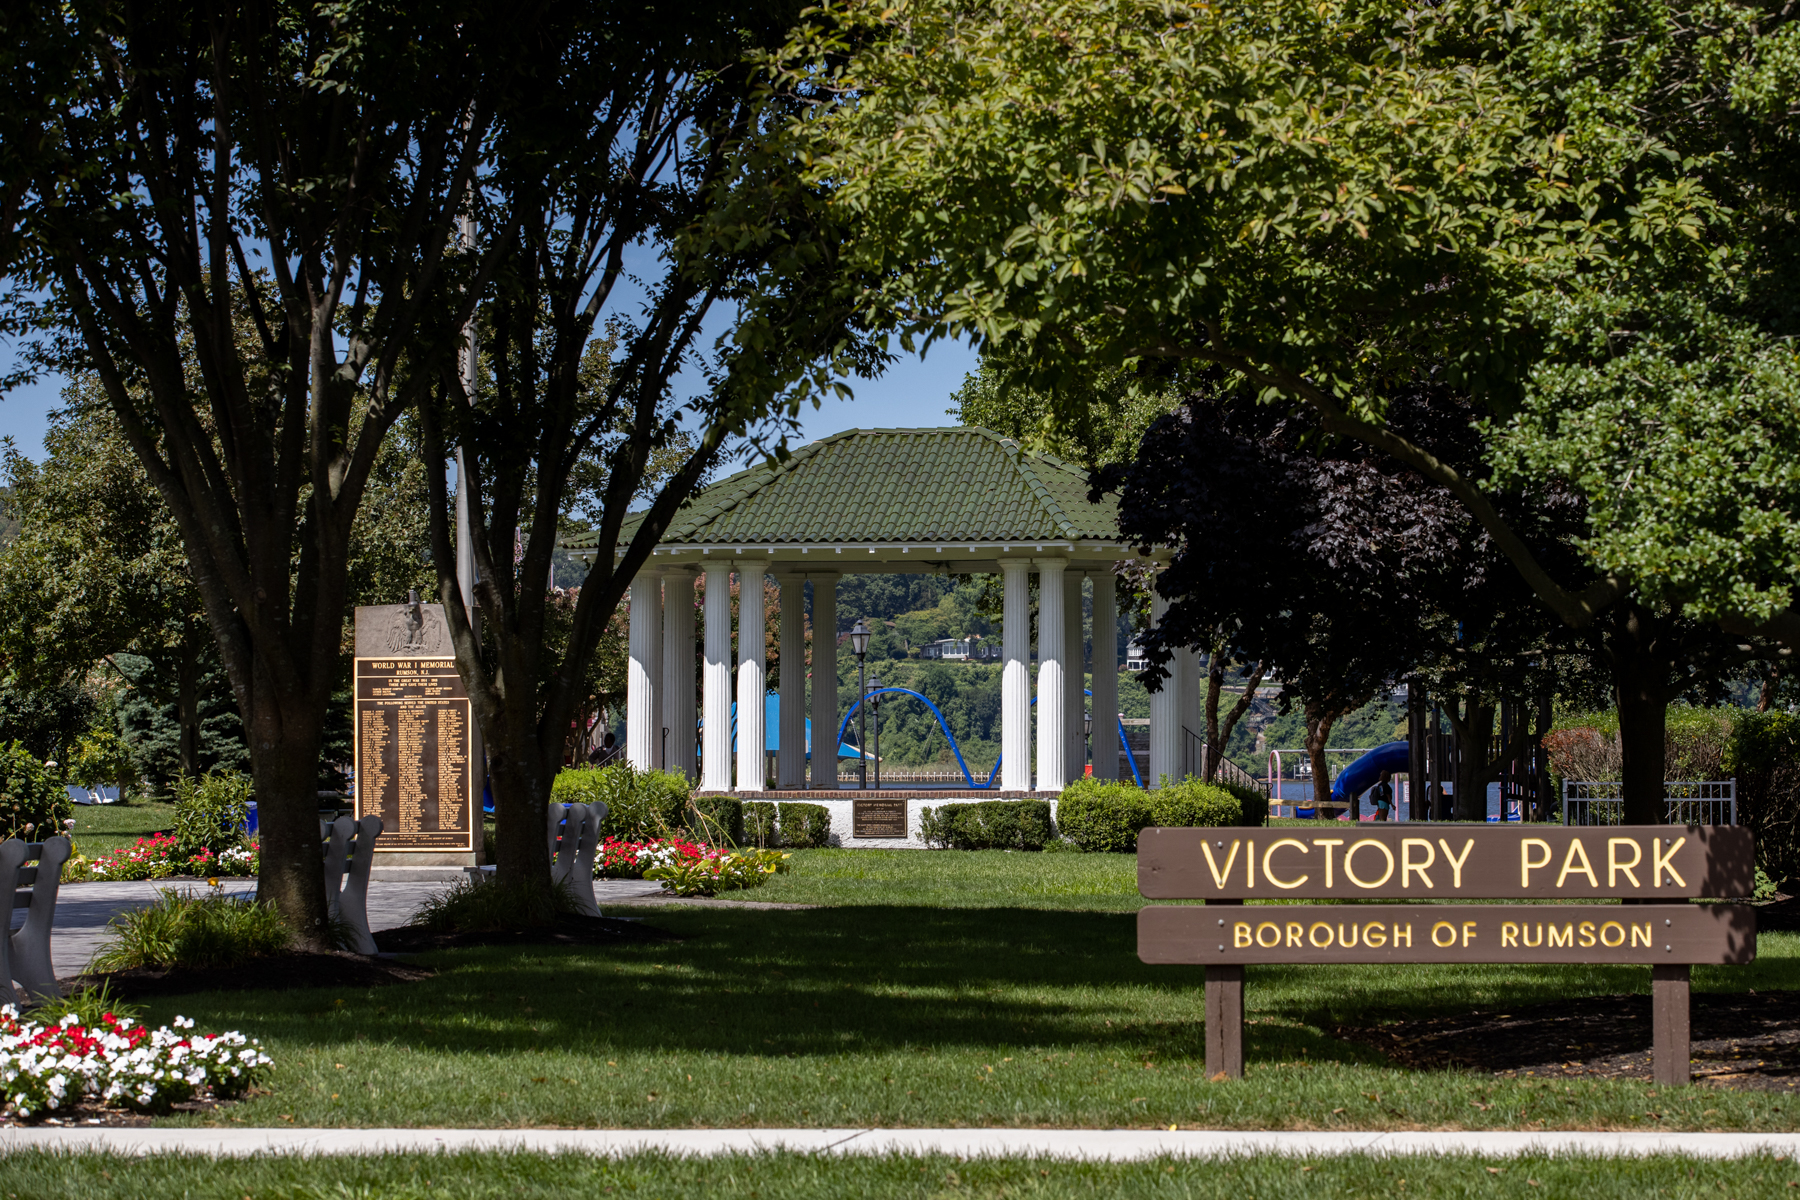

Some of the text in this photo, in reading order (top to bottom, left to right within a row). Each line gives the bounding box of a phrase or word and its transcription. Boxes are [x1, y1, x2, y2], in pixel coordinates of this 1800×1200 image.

[1200, 837, 1687, 889] VICTORY PARK
[1233, 921, 1653, 948] BOROUGH OF RUMSON
